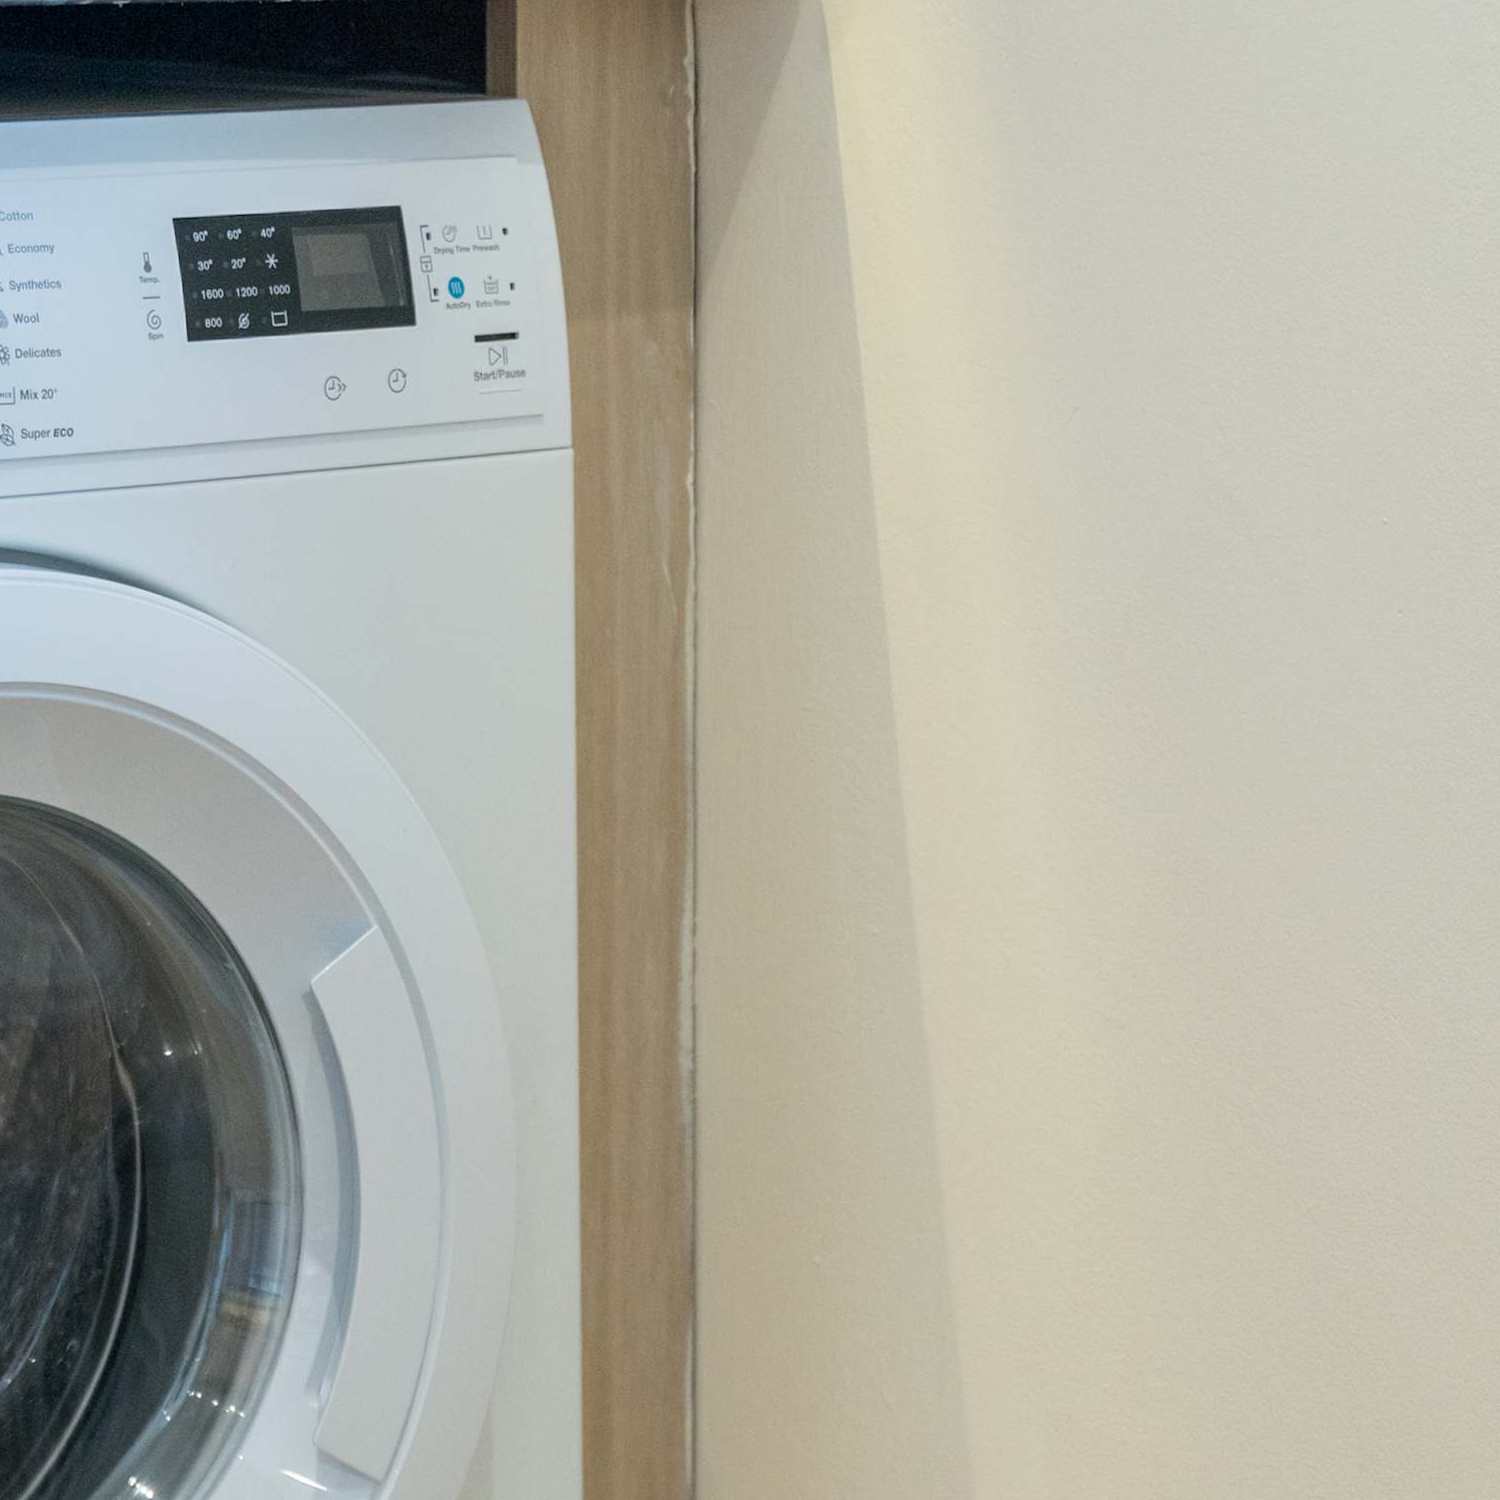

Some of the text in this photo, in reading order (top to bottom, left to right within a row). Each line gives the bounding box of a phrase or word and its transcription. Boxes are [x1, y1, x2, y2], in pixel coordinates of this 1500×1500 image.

[7, 243, 55, 255] Economy
[8, 279, 62, 292] Synthetics
[236, 286, 258, 298] 1200
[269, 284, 291, 296] 1000
[13, 313, 40, 324] Wool
[204, 317, 222, 328] 800
[147, 332, 164, 341] Spin
[14, 348, 62, 359] Delicates
[473, 368, 526, 381] Start/Pause
[19, 389, 39, 400] Mix
[20, 428, 74, 440] Super ECO
